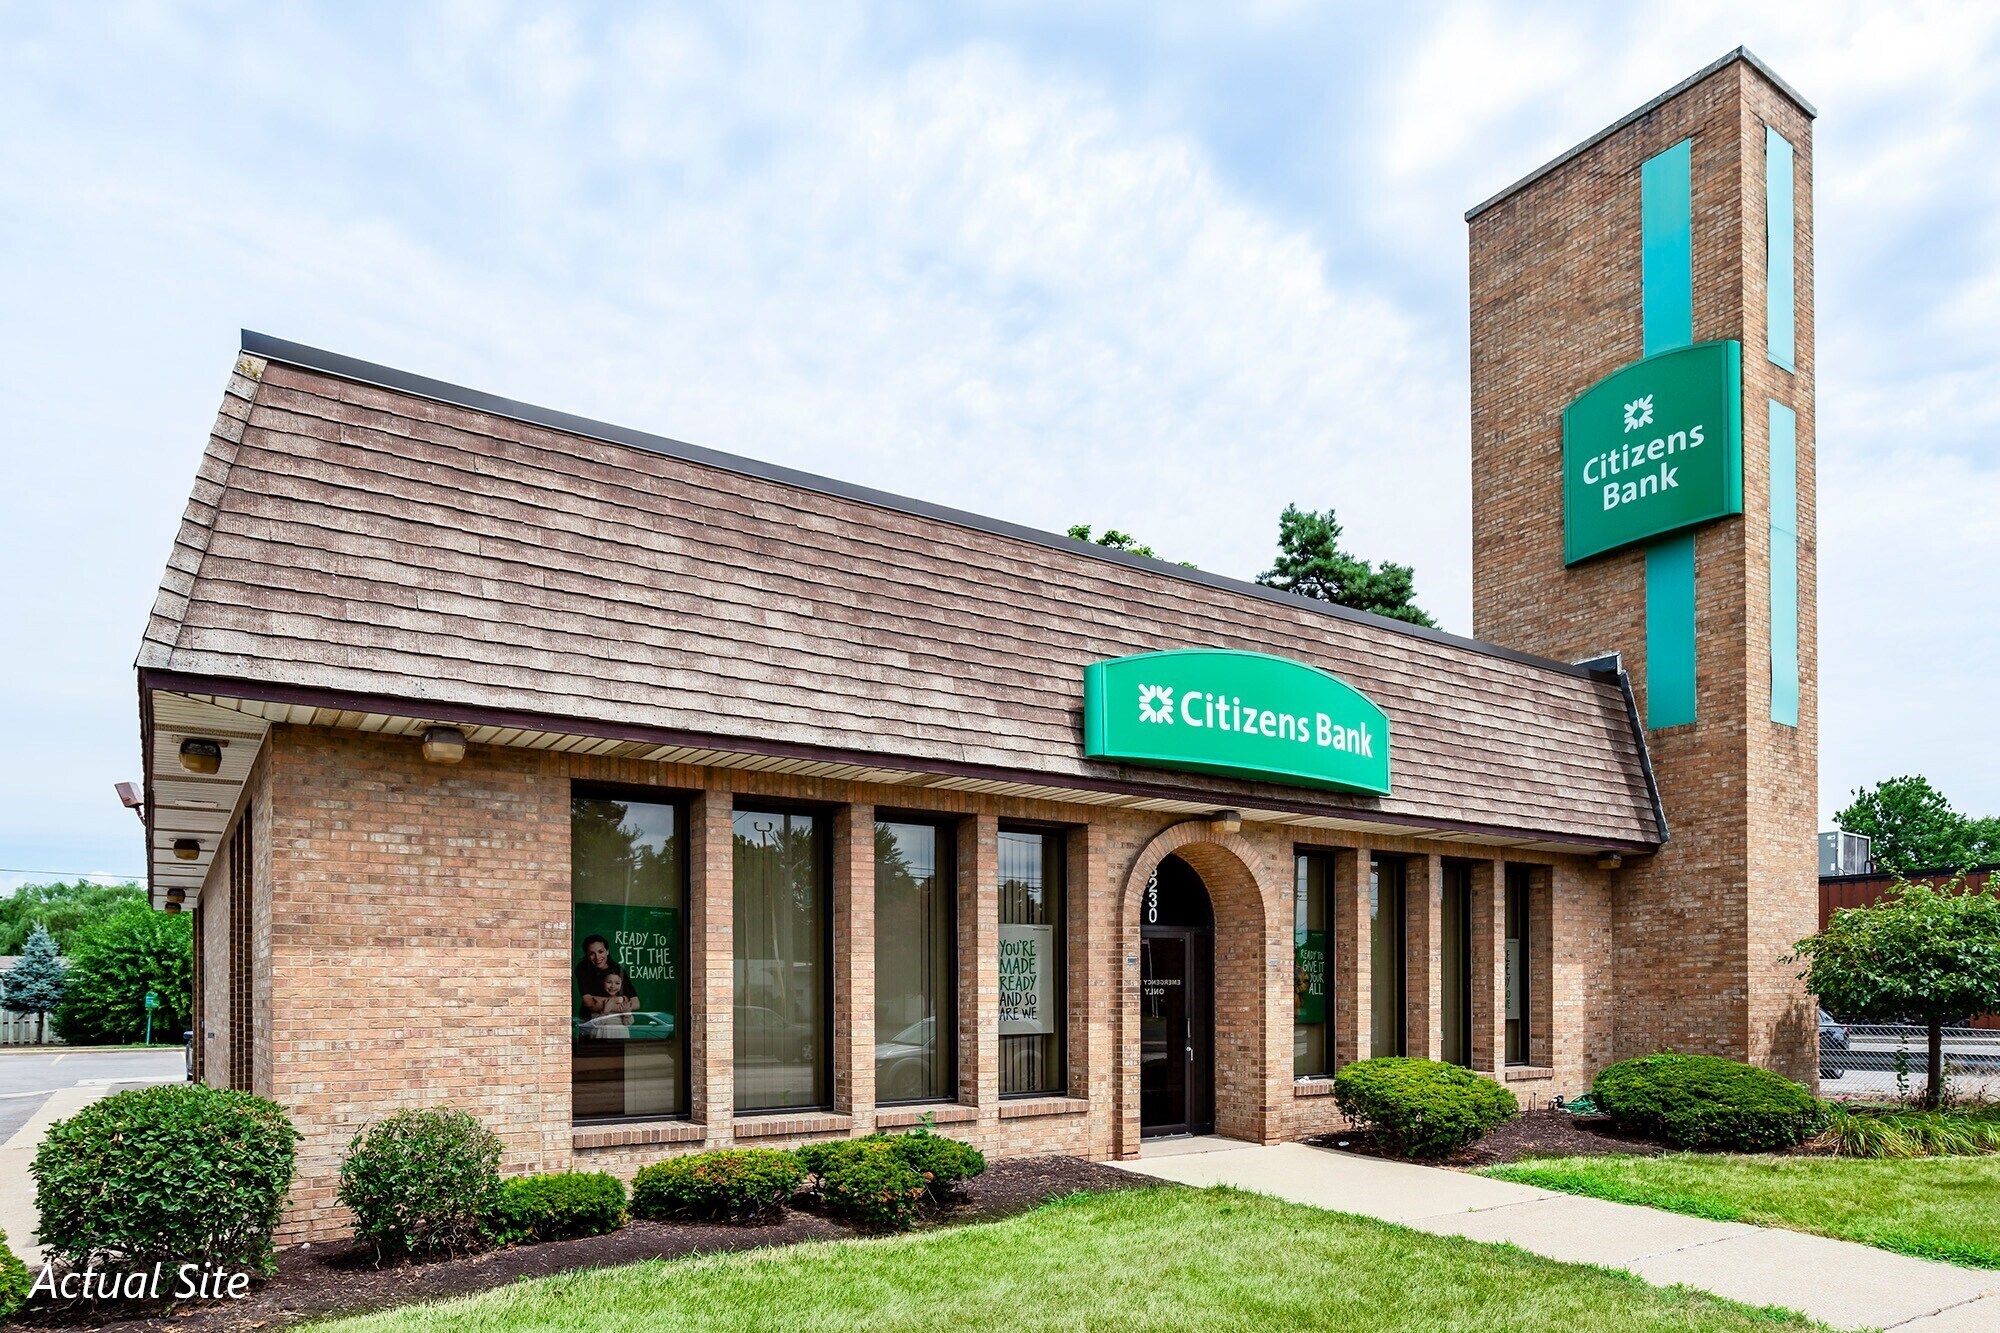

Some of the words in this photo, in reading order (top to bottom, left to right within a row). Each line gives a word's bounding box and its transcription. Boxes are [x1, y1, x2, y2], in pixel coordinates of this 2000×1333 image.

[1583, 424, 1704, 485] Citizens
[1603, 462, 1679, 511] Bank
[1180, 690, 1310, 743] Citizens
[1316, 712, 1373, 758] Bank
[615, 930, 649, 946] READY
[618, 946, 644, 965] SET
[646, 947, 671, 966] THE
[1000, 939, 1036, 957] YOU'RE
[1301, 949, 1317, 960] READY
[629, 965, 675, 979] EXAMPLE
[1000, 957, 1036, 975] MADE
[1303, 960, 1317, 972] GIVE
[1000, 975, 1037, 992] READY
[1309, 982, 1323, 995] ALL
[1000, 992, 1022, 1007] AND
[1024, 992, 1037, 1006] SO
[1000, 1007, 1019, 1021] ARE
[1021, 1006, 1038, 1020] WE
